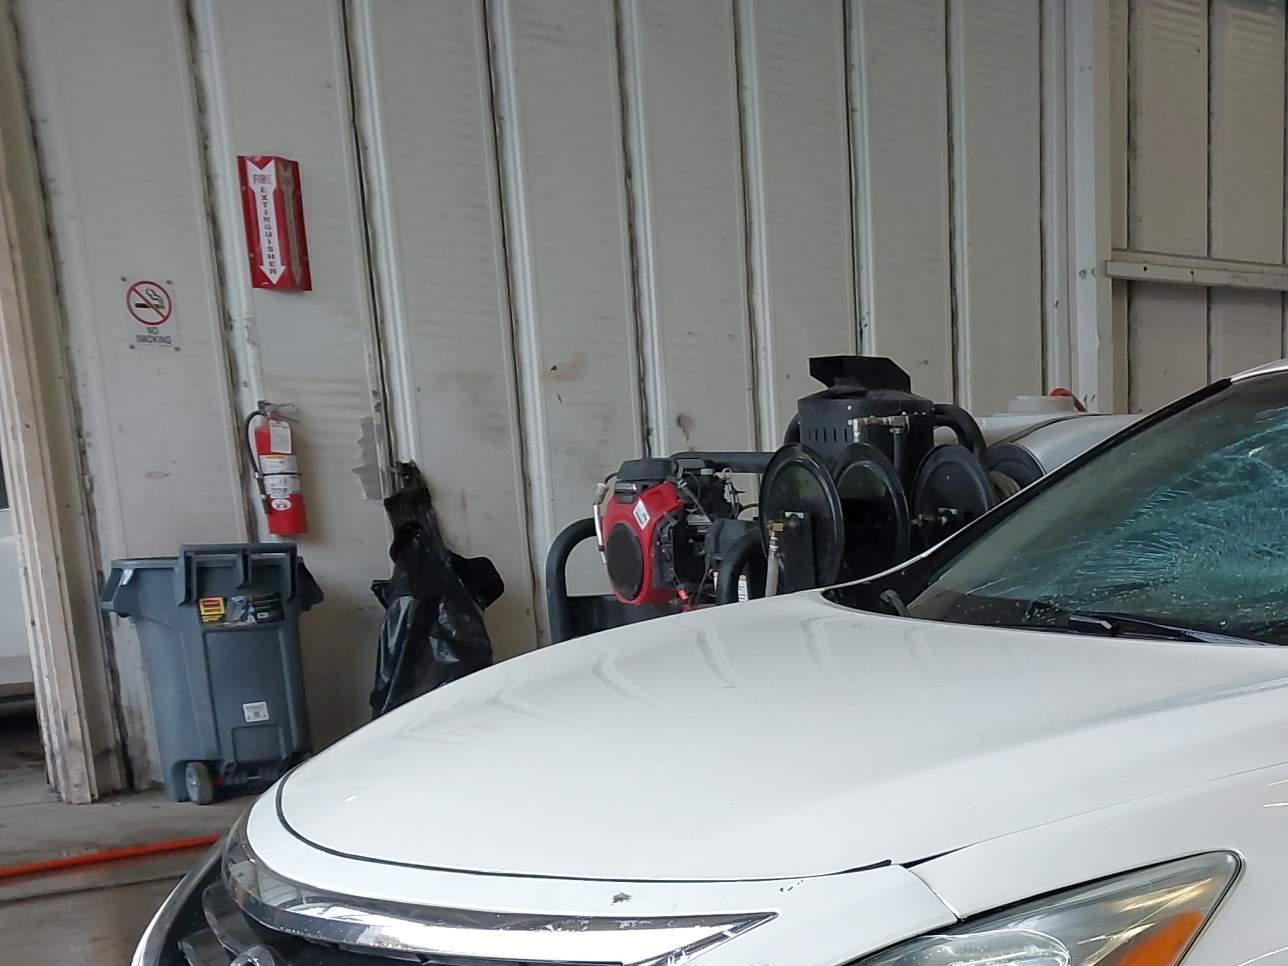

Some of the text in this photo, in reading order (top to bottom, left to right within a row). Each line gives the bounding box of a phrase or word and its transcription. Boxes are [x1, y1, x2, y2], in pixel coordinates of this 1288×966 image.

[253, 174, 272, 184] FIRE
[260, 186, 277, 275] EXTINGUISHER
[147, 326, 159, 335] NO
[135, 334, 172, 344] SMOKING
